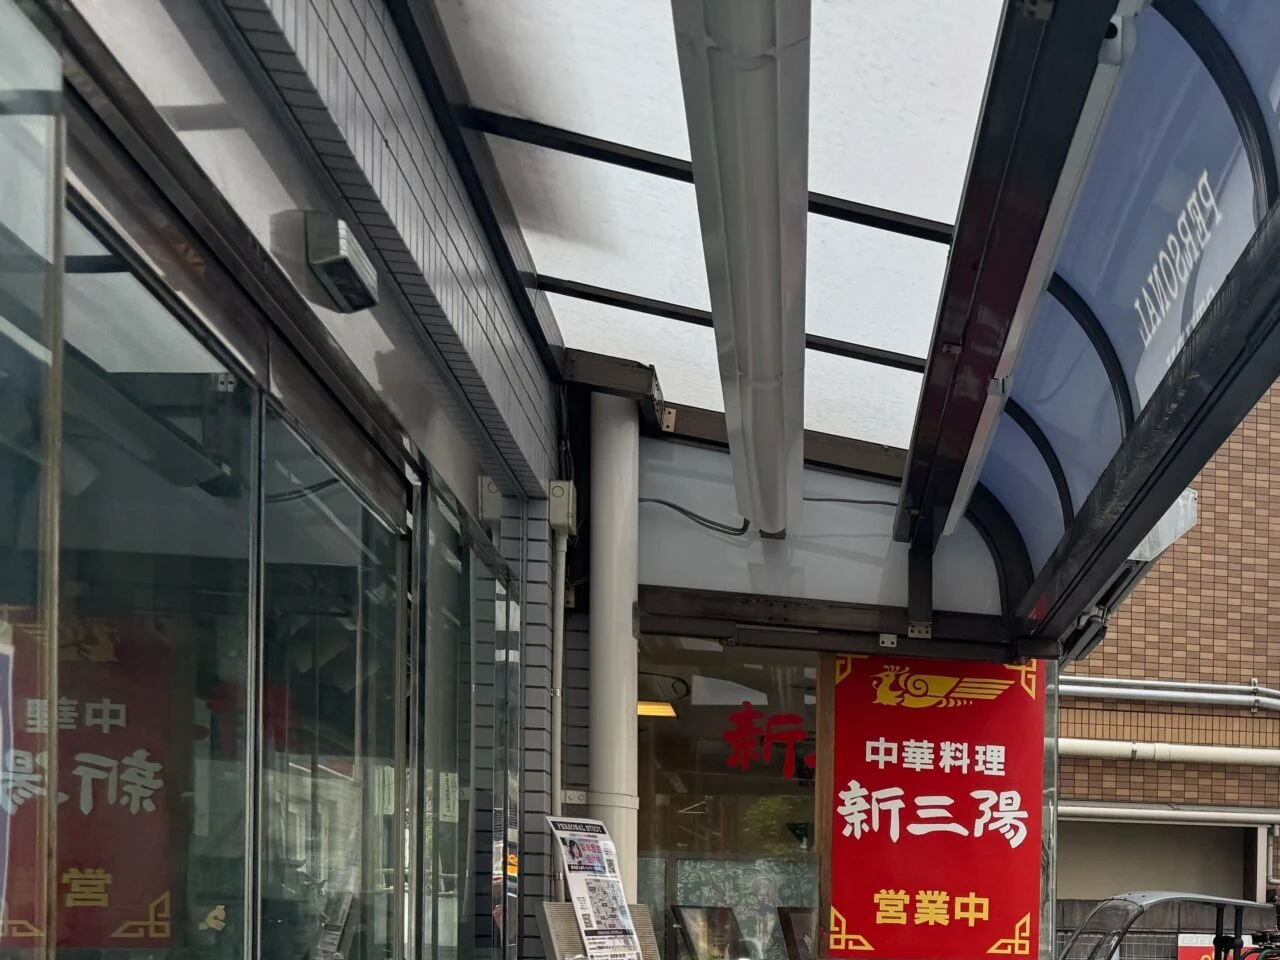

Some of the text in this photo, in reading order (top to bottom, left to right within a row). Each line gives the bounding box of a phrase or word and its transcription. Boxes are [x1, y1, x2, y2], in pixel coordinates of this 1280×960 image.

[864, 736, 1006, 777] 中華料理
[836, 779, 1029, 849] 新三陽
[872, 889, 990, 927] 営業中
